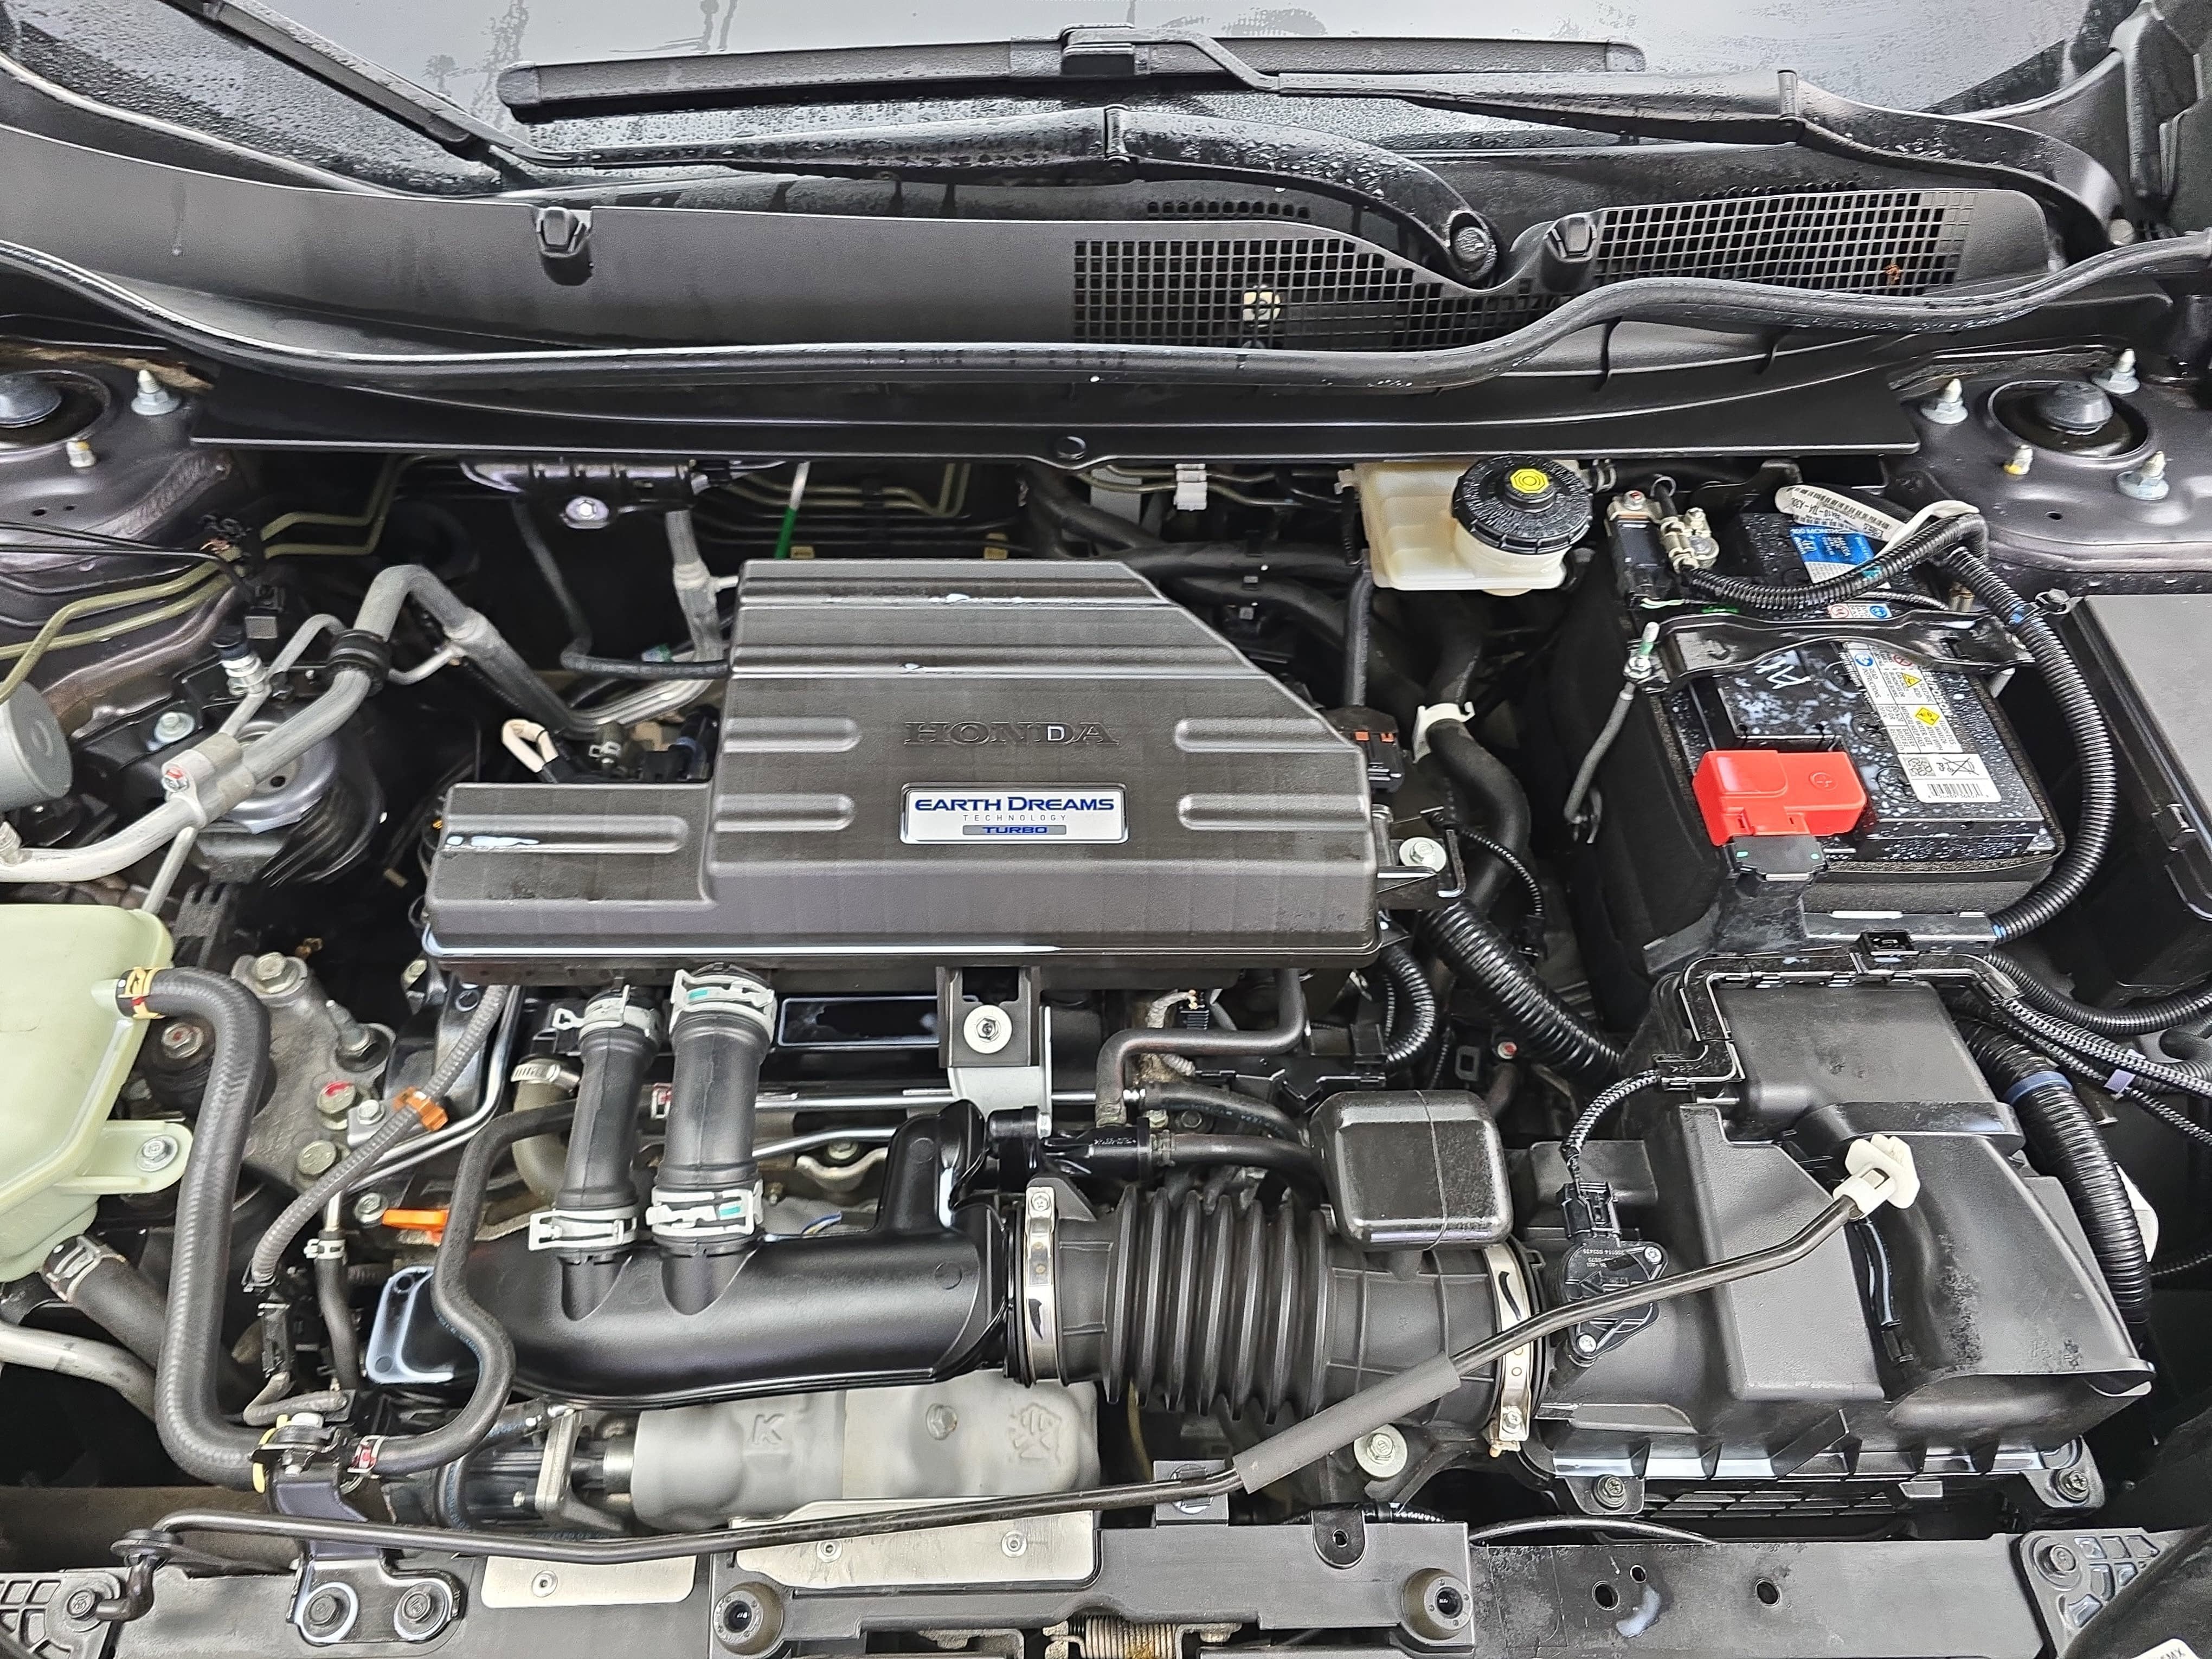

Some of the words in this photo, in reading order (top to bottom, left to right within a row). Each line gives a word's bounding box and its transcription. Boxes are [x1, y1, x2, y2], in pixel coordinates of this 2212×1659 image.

[1912, 688, 1923, 697] ACID
[1899, 706, 1914, 724] MEDICAL
[1909, 725, 1920, 736] HELP
[1938, 721, 1950, 733] FLUSH
[1945, 735, 1956, 744] EYES
[904, 722, 1120, 745] HONDA
[1895, 729, 1907, 740] MUST
[1901, 729, 1917, 746] BATTERY
[1926, 726, 1937, 738] ATELY
[1932, 739, 1944, 750] WITH
[915, 799, 1002, 811] EARTH
[1007, 796, 1114, 811] DREAMS
[752, 1413, 786, 1445] K
